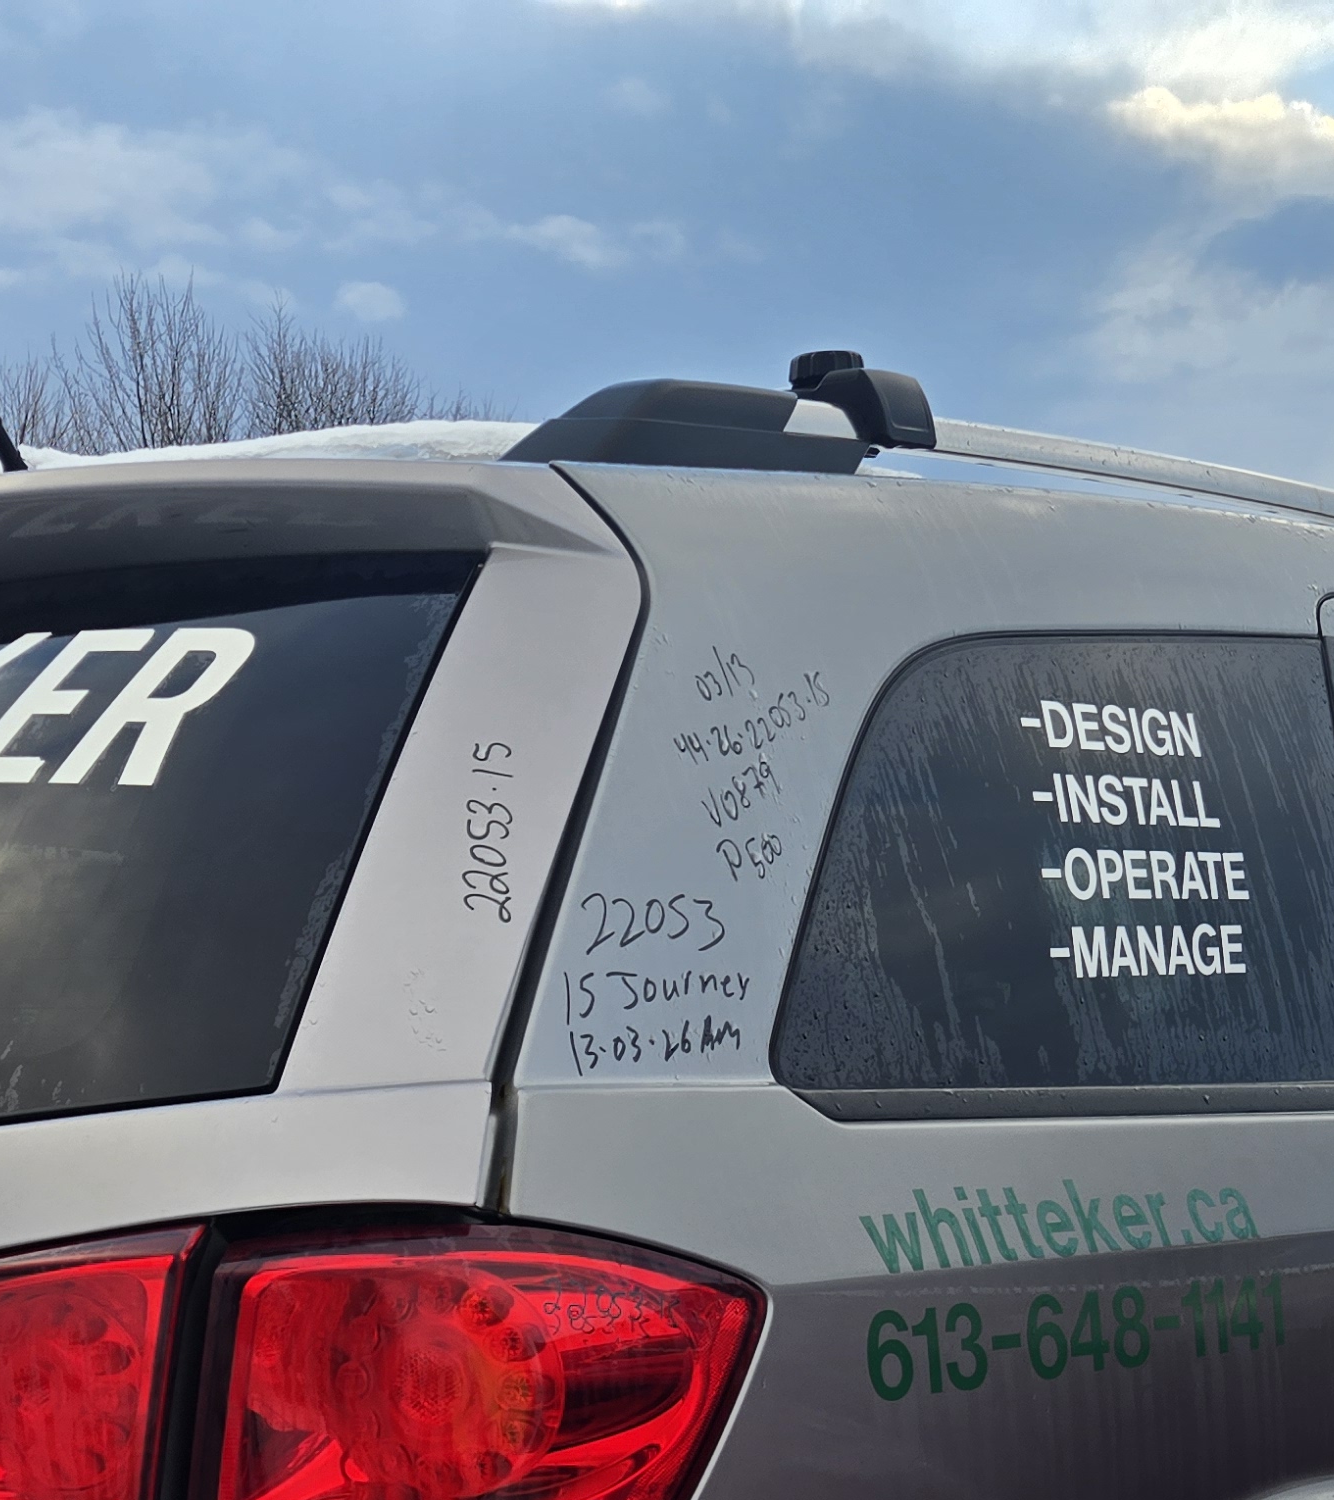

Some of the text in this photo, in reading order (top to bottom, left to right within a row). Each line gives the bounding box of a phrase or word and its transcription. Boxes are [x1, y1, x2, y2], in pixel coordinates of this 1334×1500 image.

[694, 645, 756, 702] 03/13
[580, 893, 727, 956] 22053
[563, 970, 752, 1027] 15 Journey
[859, 1178, 1261, 1275] whitteker.ca
[867, 1272, 1285, 1401] 613-648-1141
